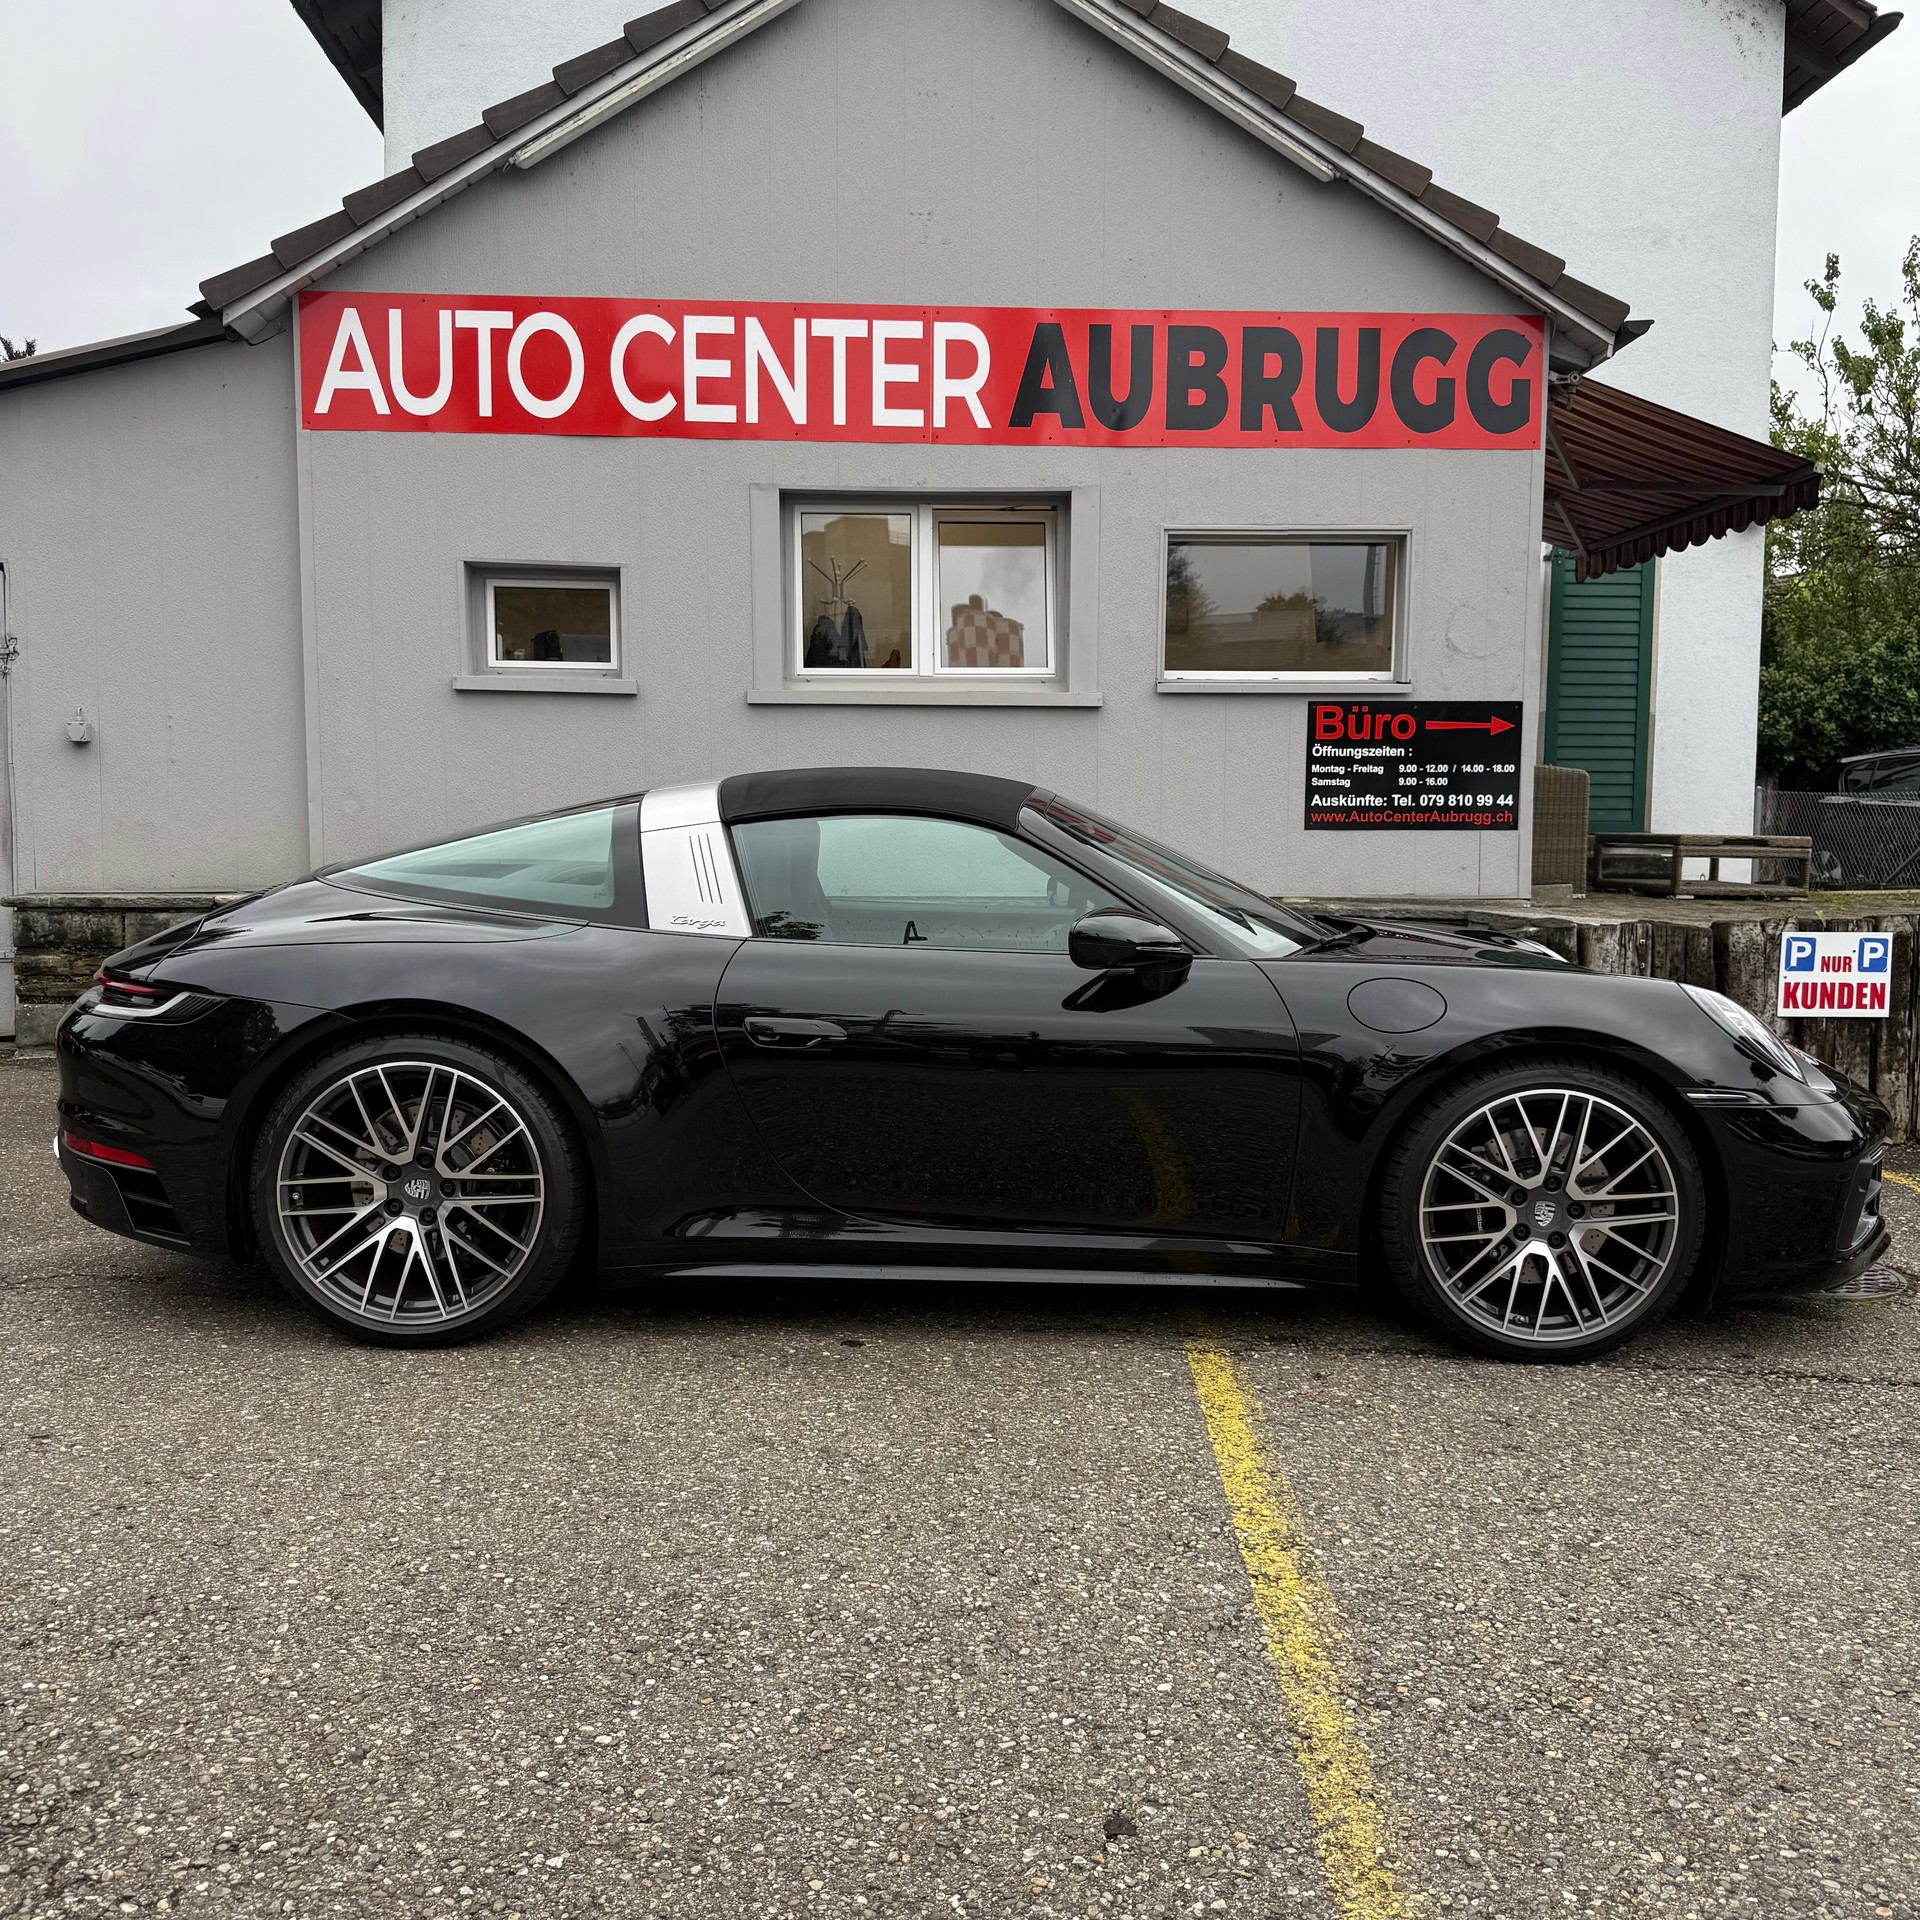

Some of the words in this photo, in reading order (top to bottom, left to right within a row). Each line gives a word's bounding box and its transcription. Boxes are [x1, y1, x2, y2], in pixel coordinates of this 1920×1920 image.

[314, 307, 585, 419] AUTO
[610, 313, 993, 430] CENTER
[1007, 322, 1533, 435] AUBRUGG
[1315, 705, 1416, 740] Büro
[1312, 743, 1405, 759] Öffnungszeiten
[1311, 764, 1345, 775] Montag
[1353, 764, 1384, 775] Freitag
[1398, 764, 1418, 773] 9.00
[1425, 764, 1449, 773] 12.00
[1461, 764, 1485, 773] 14.00
[1492, 764, 1516, 773] 18.00
[1311, 777, 1351, 788] Samstag
[1398, 777, 1418, 786] 9.00
[1425, 777, 1449, 786] 16.00
[1311, 794, 1387, 807] Auskünfte:
[1392, 794, 1416, 807] Tel.
[1420, 794, 1444, 807] 079
[1448, 794, 1473, 807] 810
[1476, 794, 1493, 807] 99
[1496, 794, 1514, 807] 44
[1311, 810, 1514, 826] www.AutoCenterAubrugg.ch
[670, 915, 726, 930] Targa
[1790, 941, 1812, 967] P
[1820, 956, 1853, 972] NUR
[1863, 942, 1885, 968] P
[1782, 982, 1886, 1010] KUNDEN
